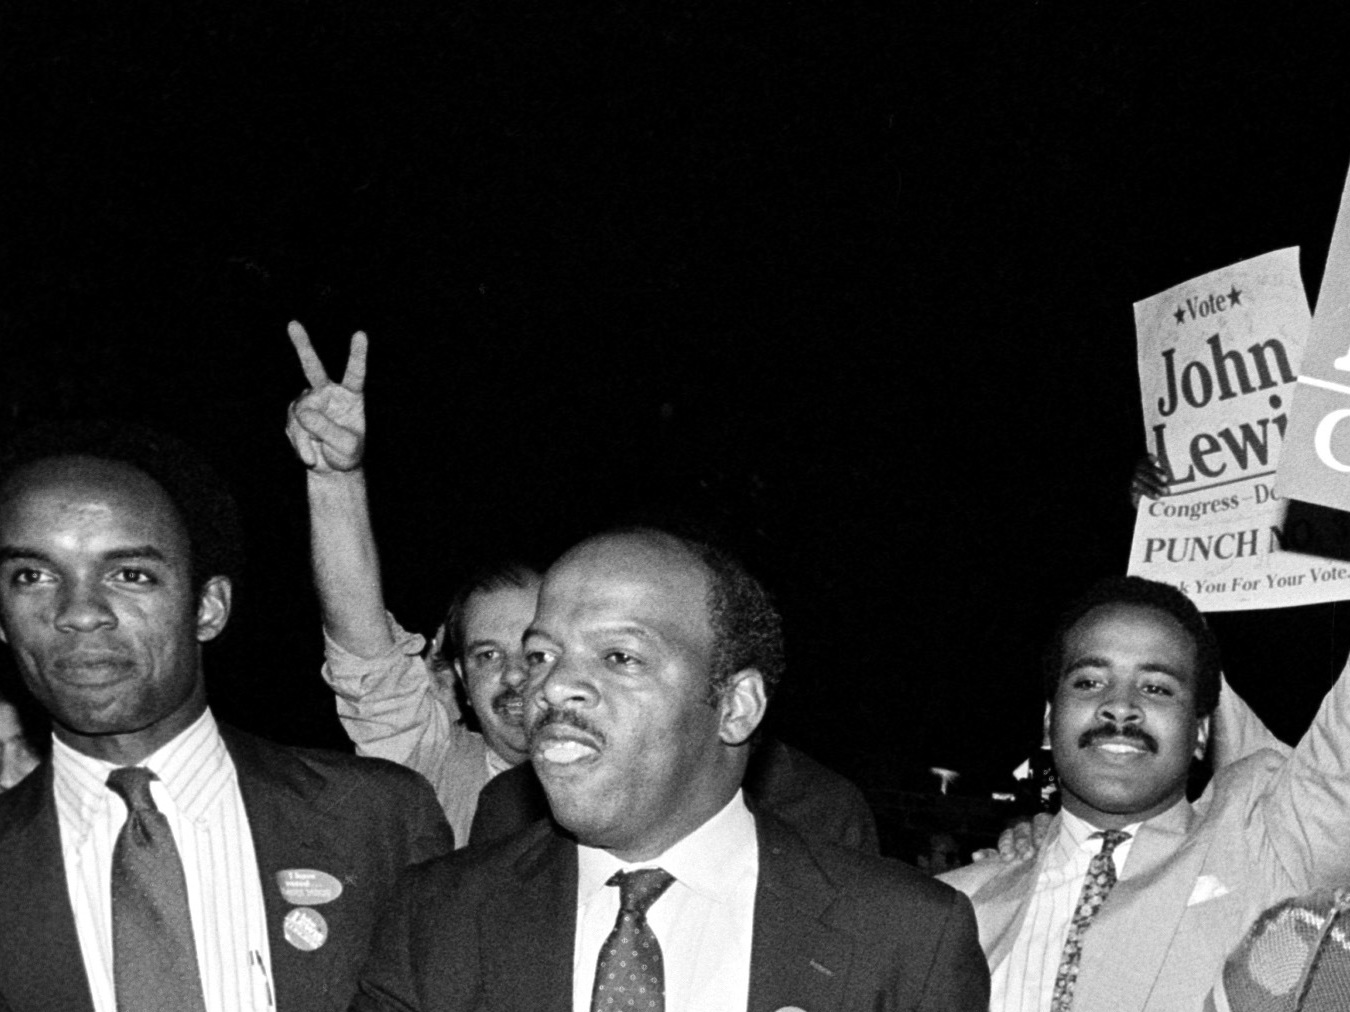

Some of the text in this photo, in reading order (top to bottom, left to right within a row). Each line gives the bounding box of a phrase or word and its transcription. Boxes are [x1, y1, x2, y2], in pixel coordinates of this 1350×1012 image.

[1186, 293, 1227, 320] Vote
[1158, 333, 1298, 417] John
[1152, 394, 1288, 487] Lewi
[1148, 495, 1240, 521] Congress
[1143, 528, 1260, 563] PUNCH
[1195, 580, 1226, 594] You
[1231, 577, 1262, 592] For
[1266, 573, 1306, 589] Your
